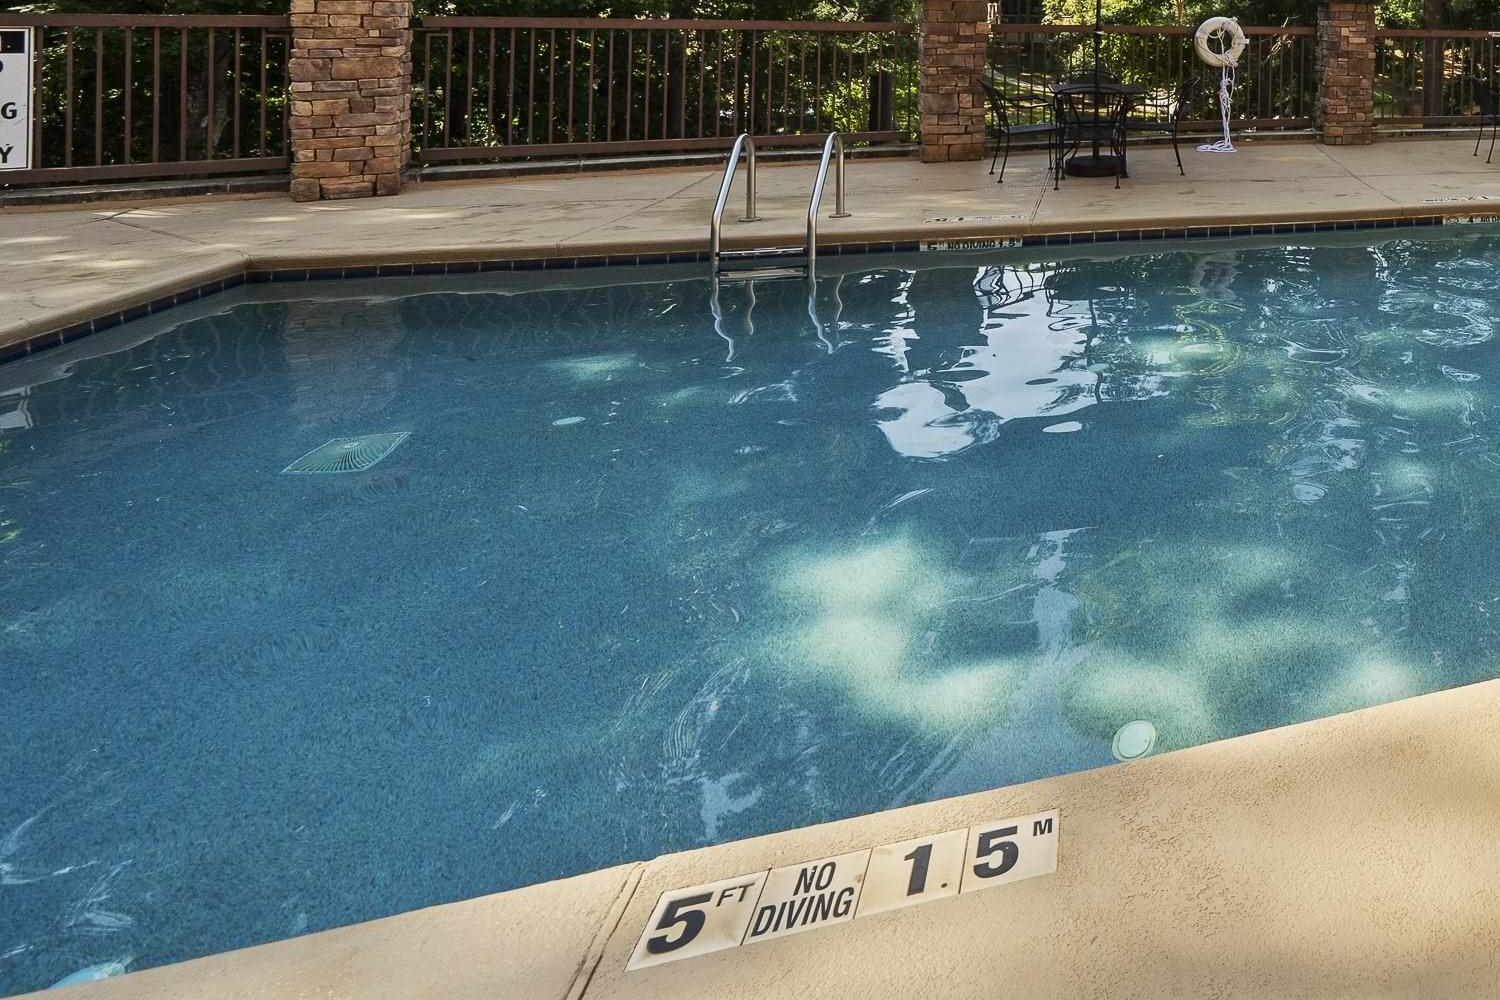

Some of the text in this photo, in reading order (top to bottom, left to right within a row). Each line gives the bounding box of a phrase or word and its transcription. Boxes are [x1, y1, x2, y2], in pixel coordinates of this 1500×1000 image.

[1032, 817, 1053, 837] M
[793, 861, 837, 896] NO
[646, 882, 756, 954] 5 FT
[750, 886, 855, 938] DIVING
